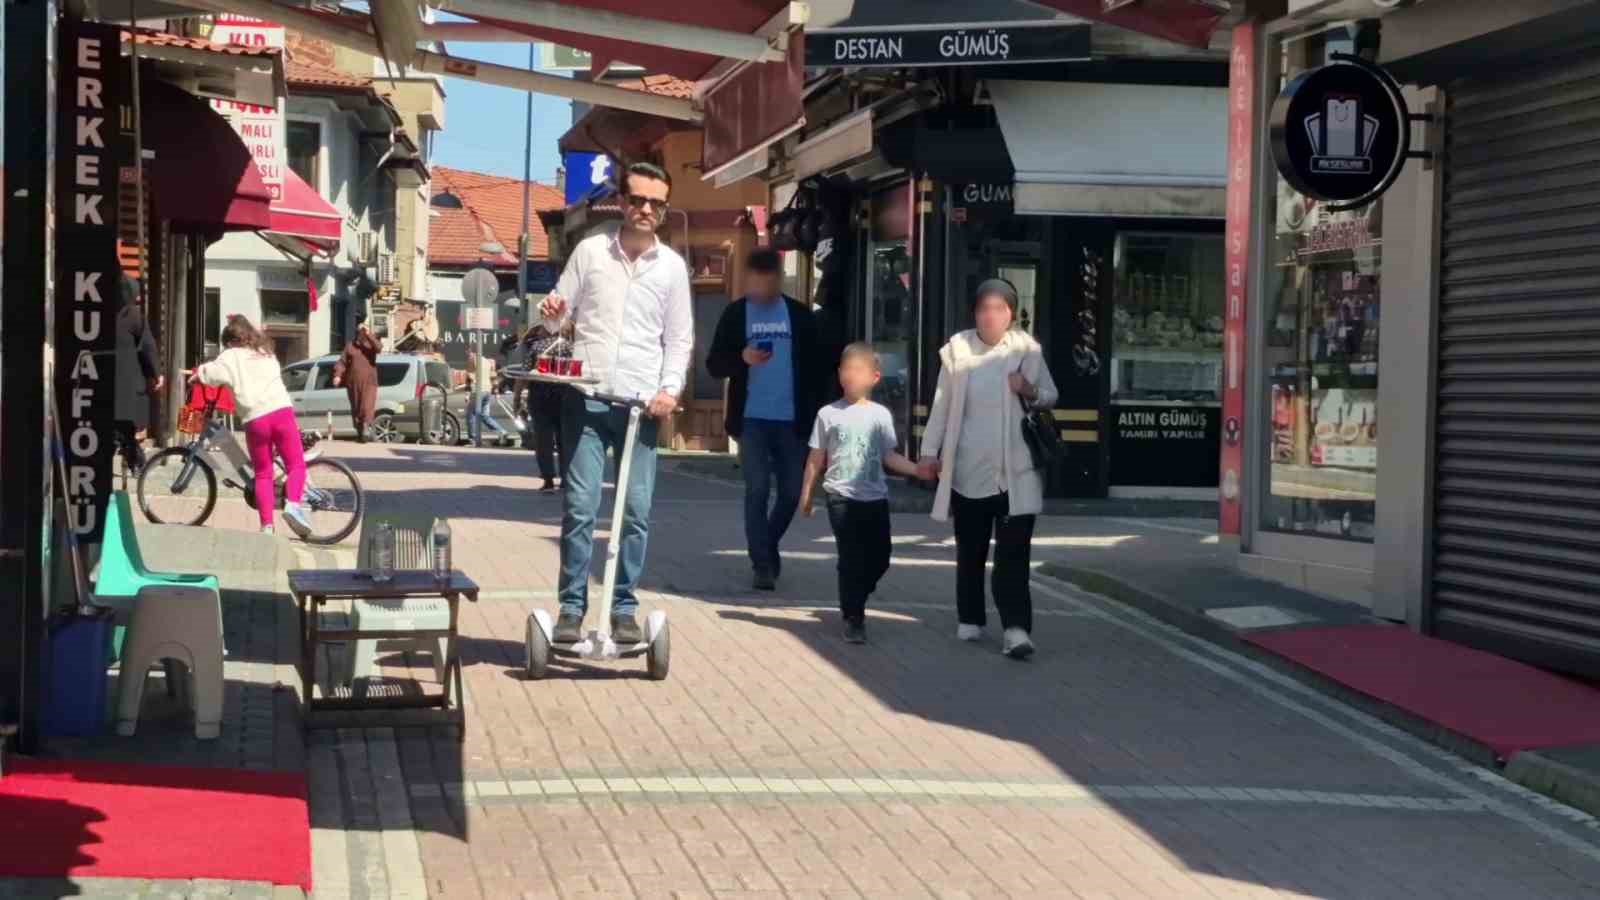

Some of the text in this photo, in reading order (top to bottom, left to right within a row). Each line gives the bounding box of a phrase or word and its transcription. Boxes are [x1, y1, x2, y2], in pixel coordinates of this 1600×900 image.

[835, 30, 1009, 60] DESTAN GÜMÜŞ
[75, 37, 104, 225] ERKEK
[69, 271, 102, 535] KUAFÖRÜ
[1118, 409, 1207, 429] ALTIN GÜMÜŞ
